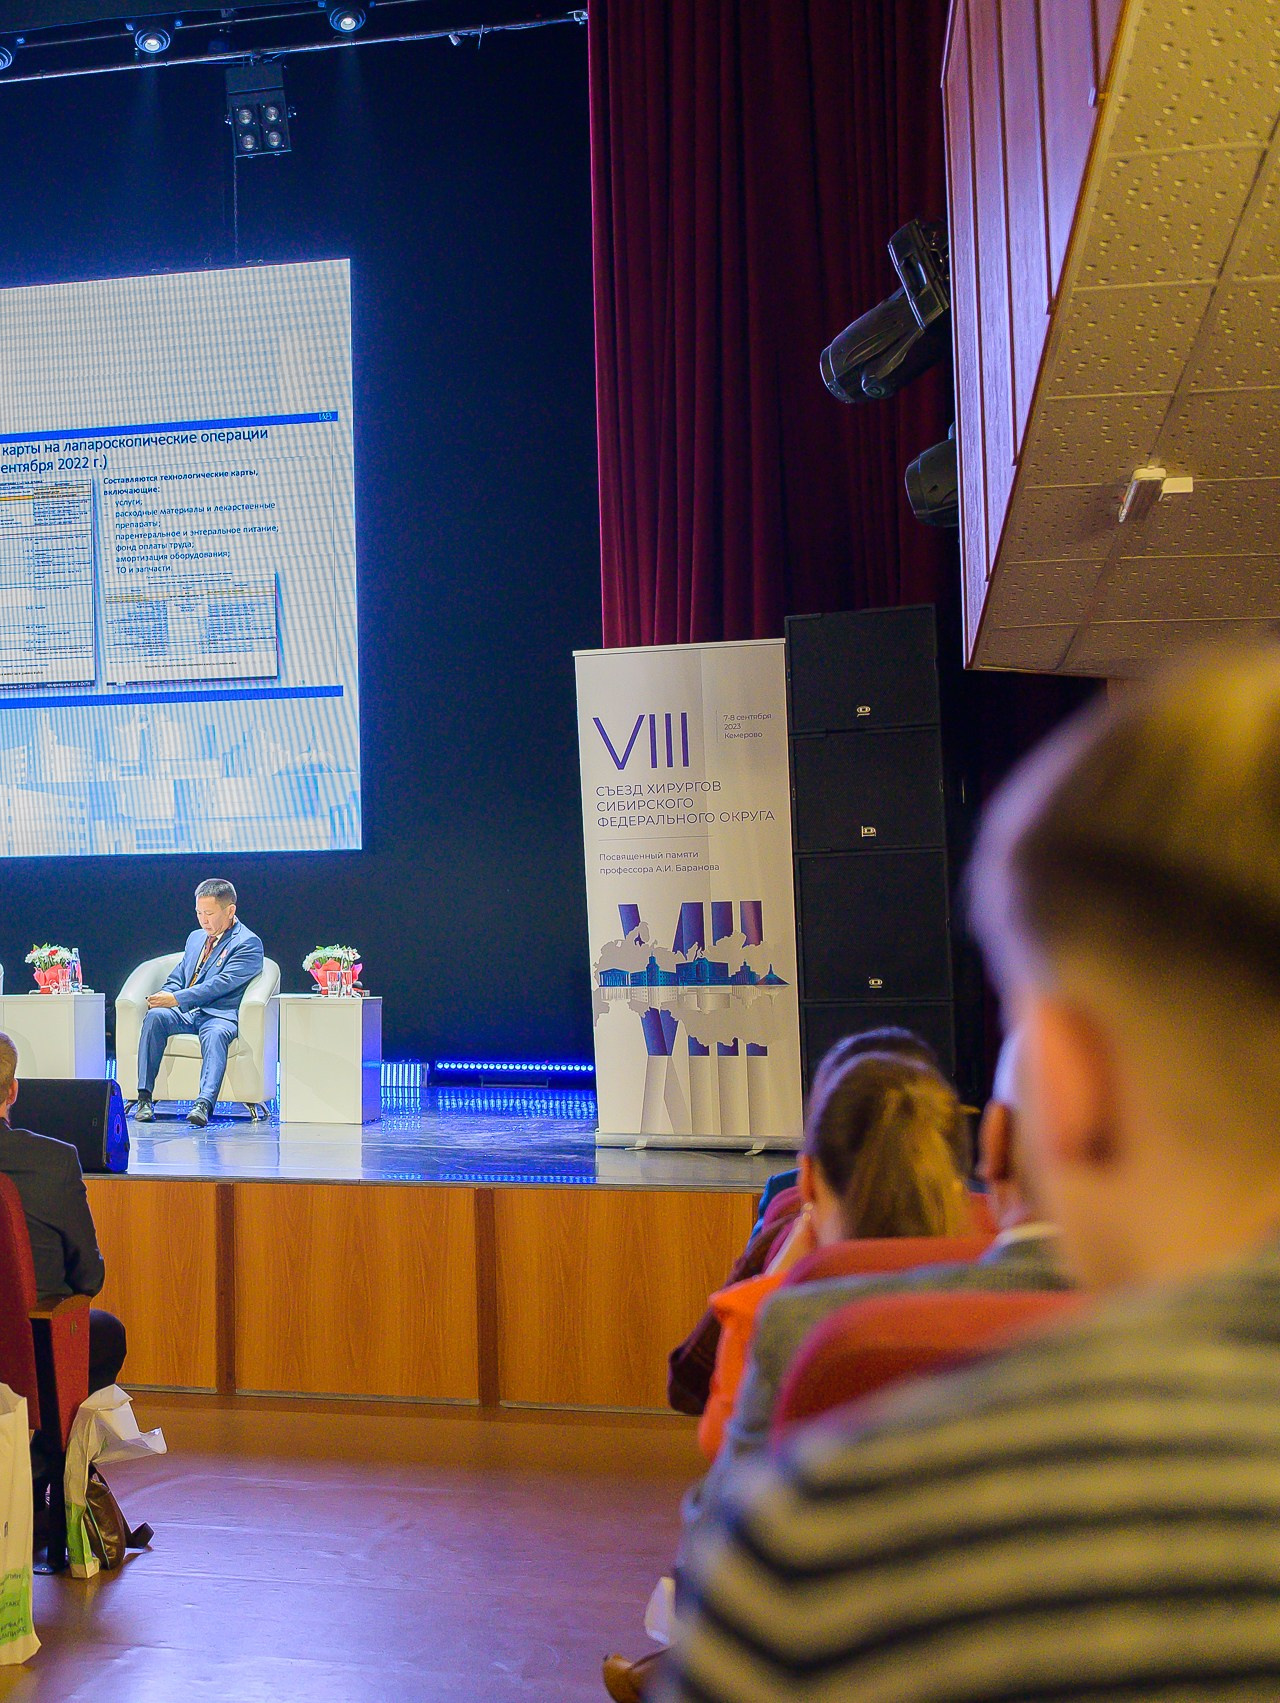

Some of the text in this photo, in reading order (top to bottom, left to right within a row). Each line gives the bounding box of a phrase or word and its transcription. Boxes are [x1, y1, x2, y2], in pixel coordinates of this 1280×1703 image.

[2, 442, 41, 457] карты
[44, 441, 61, 452] на
[64, 431, 197, 452] лапароскопические
[200, 429, 269, 445] операции
[57, 457, 90, 470] 2022
[93, 454, 108, 470] г.)
[103, 469, 259, 485] Составляются технологические карты,
[103, 487, 161, 496] включающие:
[115, 509, 158, 519] расходные
[160, 507, 205, 515] материалы
[214, 502, 276, 512] лекарственные
[115, 531, 181, 541] парентеральное
[190, 527, 241, 537] энтеральное
[115, 541, 194, 553] фонд оплаты труда;
[115, 554, 168, 564] амортизация
[736, 712, 772, 721] сентября
[592, 712, 690, 771] VIII
[724, 731, 763, 740] Кемерово
[596, 780, 722, 798] СЪЕЗД ХИРУРГОВ
[596, 797, 694, 813] СИБИРСКОГО
[597, 810, 776, 829] ФЕДЕРАЛЬНОГО ОКРУГА
[599, 850, 699, 862] Посвященный памяти
[599, 862, 720, 876] профессора А.И. Баранова
